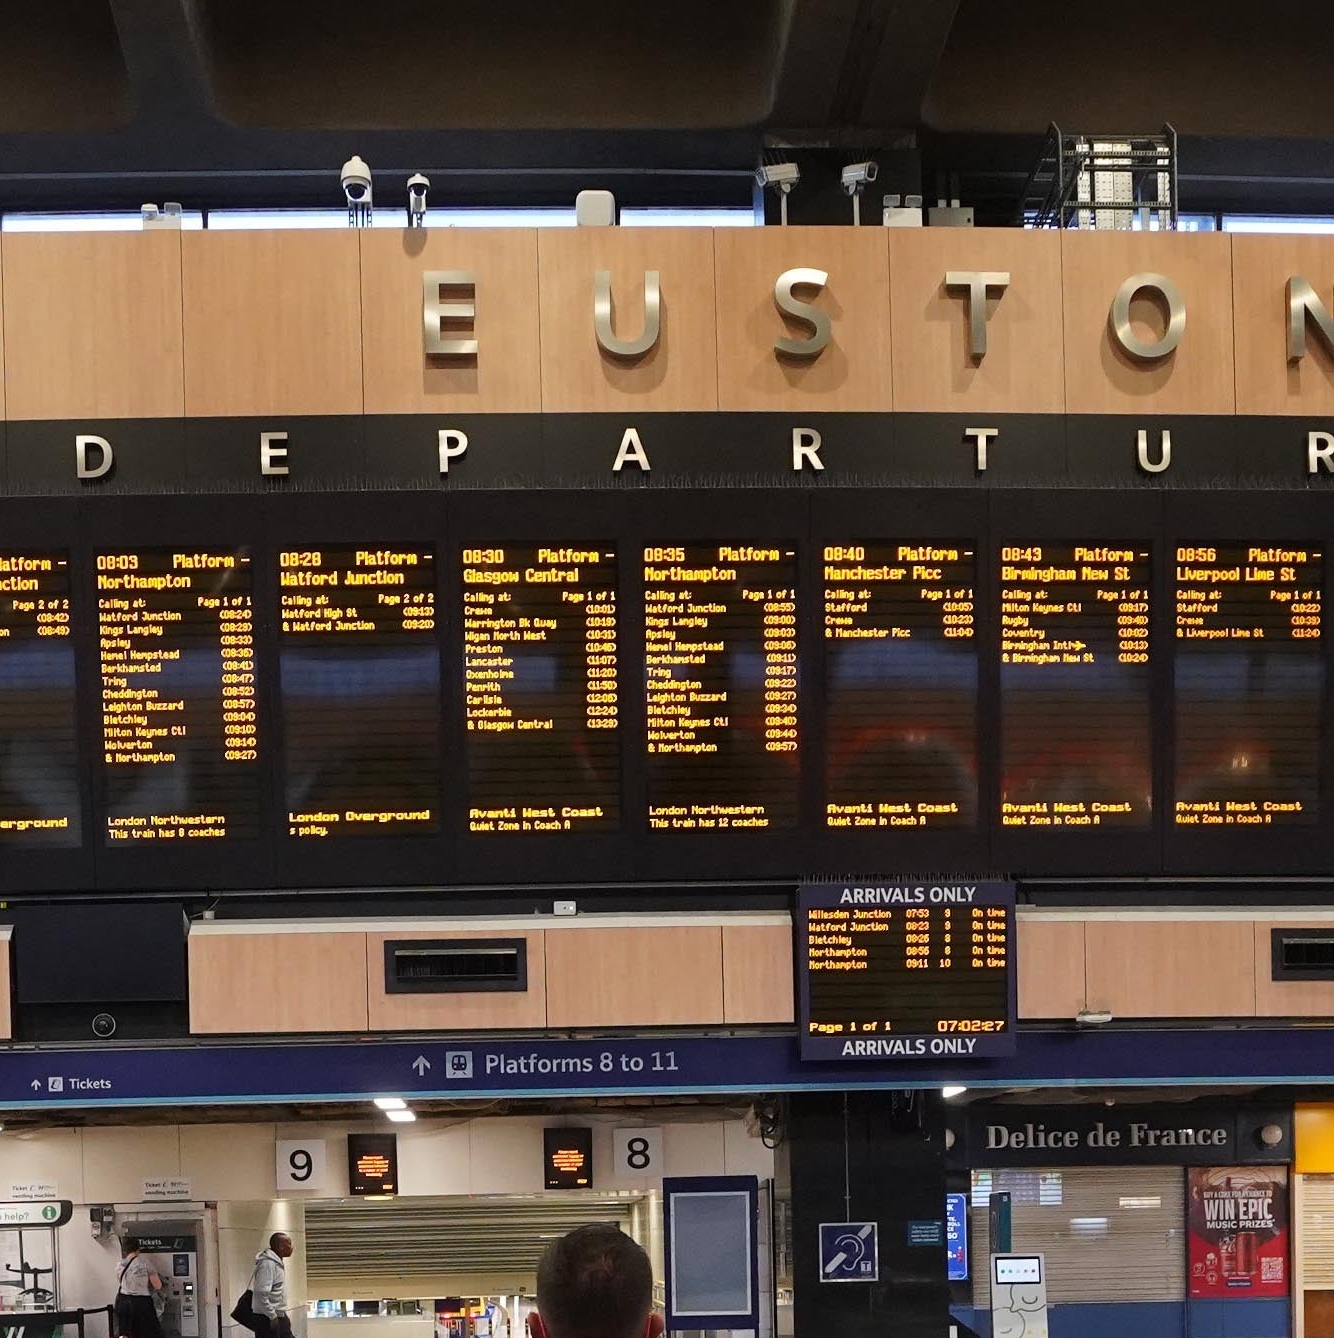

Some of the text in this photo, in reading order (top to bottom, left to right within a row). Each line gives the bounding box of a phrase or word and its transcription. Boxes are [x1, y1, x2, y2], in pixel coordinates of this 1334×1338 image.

[280, 551, 417, 567] 08:28 Platform
[463, 549, 599, 563] 08:30 Platform
[644, 547, 779, 562] 08:35 Platform
[824, 547, 958, 561] 08:40 Platform
[1002, 547, 1133, 561] 08:43 Platform
[1177, 548, 1306, 562] 08:56 Platform
[97, 554, 234, 570] 08:03 Platform
[281, 570, 404, 586] Watford Junction
[464, 568, 578, 584] Glasgow Central
[645, 567, 736, 582] Northampton
[825, 566, 942, 580] Manchester Picc
[1002, 567, 1130, 582] Birmingham New St
[1177, 567, 1296, 582] Liverpool Lime St
[98, 574, 191, 590] Northampton
[470, 807, 603, 818] Avanti West Coast
[108, 815, 225, 826] London Northwestern
[840, 887, 976, 904] ARRIVALS ONLY
[809, 910, 849, 919] Willesden
[854, 910, 891, 919] Junction
[972, 909, 983, 917] On
[987, 909, 1005, 917] time
[809, 922, 846, 931] Watford
[850, 922, 888, 931] Junction
[972, 921, 983, 930] On
[987, 921, 1005, 930] time
[809, 935, 851, 945] Bletchley
[972, 933, 983, 942] On
[987, 934, 1005, 942] time
[809, 948, 867, 957] Northampton
[972, 946, 983, 955] On
[987, 946, 1005, 955] time
[809, 960, 867, 969] Northampton
[940, 959, 951, 968] 10
[972, 958, 983, 967] On
[987, 958, 1005, 967] time
[810, 1020, 1004, 1033] Page 1 of 1 07:02:27
[842, 1038, 976, 1056] ARRIVALS ONLY
[486, 1052, 678, 1076] Platforms 8 to 11
[69, 1077, 111, 1091] Tickets
[986, 1123, 1227, 1150] Delice de France
[627, 1138, 650, 1170] 8
[289, 1149, 313, 1182] 9
[1204, 1198, 1272, 1220] WIN EPIC
[4, 1212, 29, 1222] help?
[1207, 1221, 1237, 1229] MUSIC
